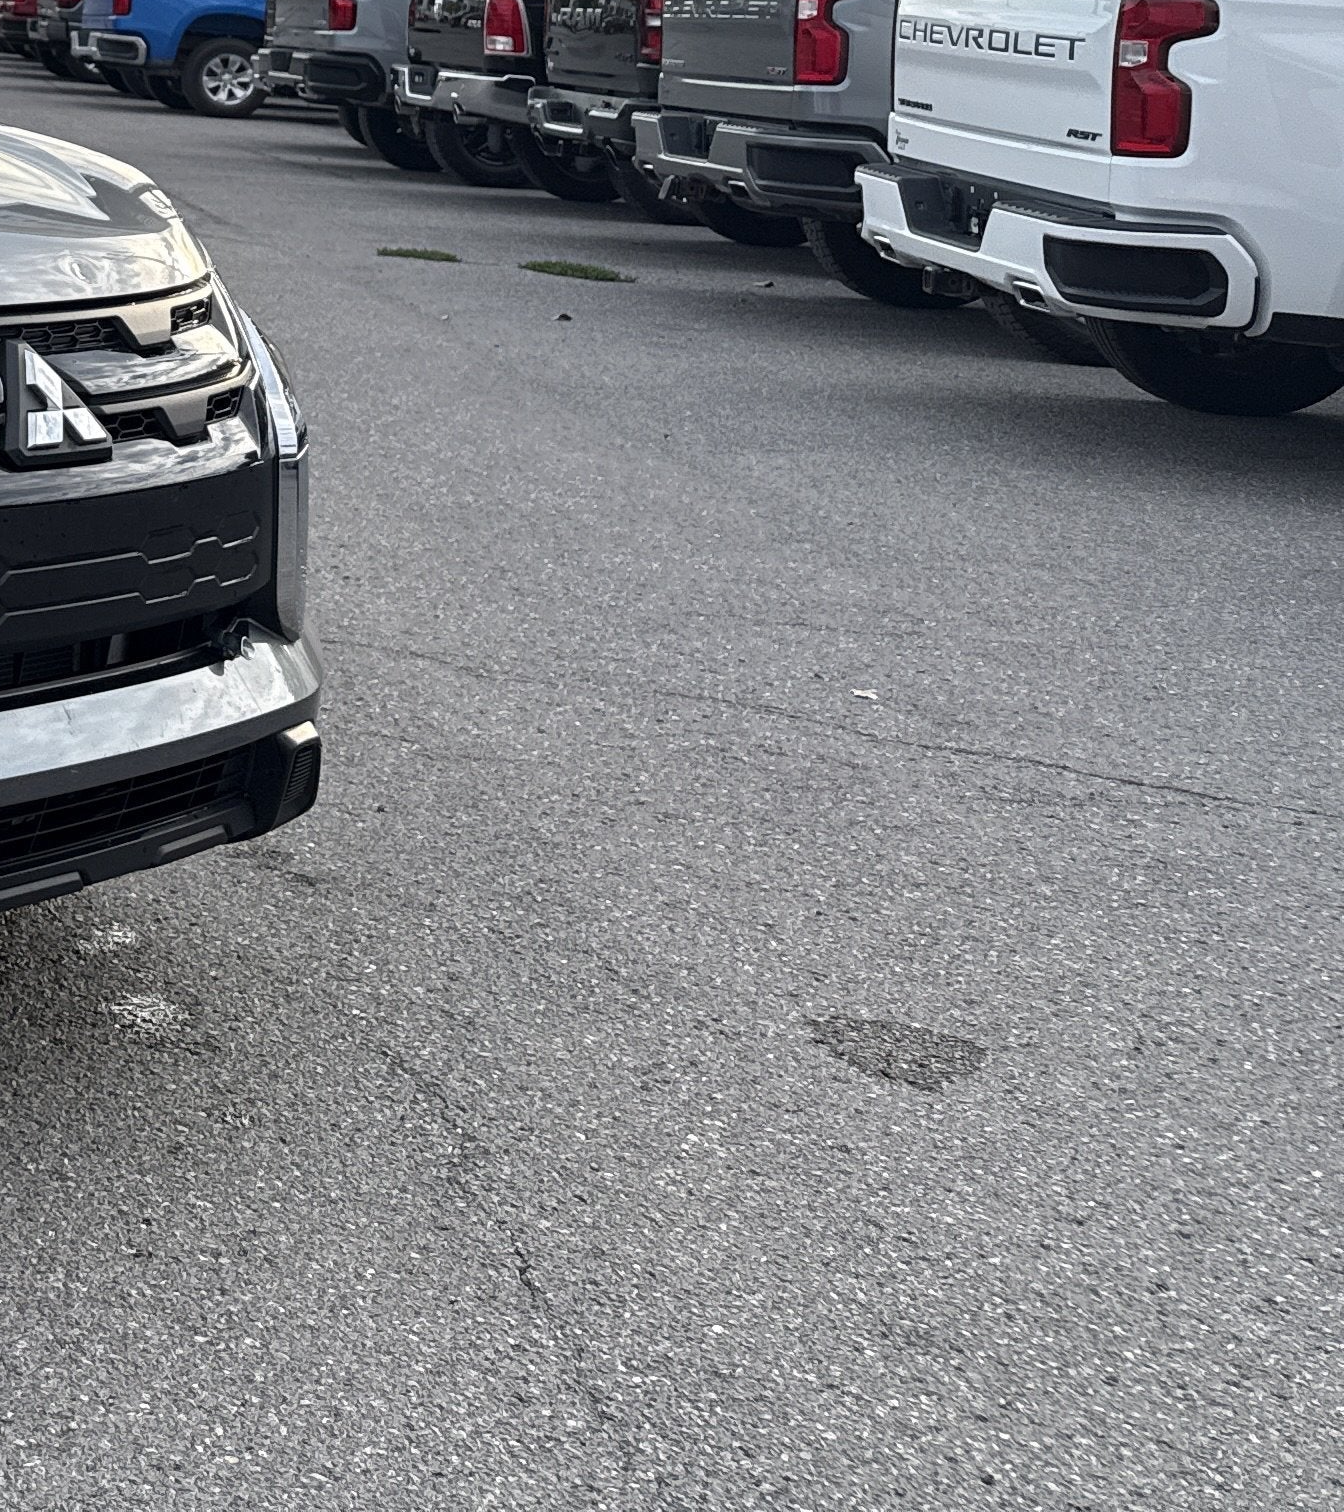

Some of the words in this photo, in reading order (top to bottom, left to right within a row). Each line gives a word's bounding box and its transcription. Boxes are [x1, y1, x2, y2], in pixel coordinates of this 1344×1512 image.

[558, 7, 603, 29] RAM
[898, 19, 1087, 61] CHEVROLET
[1065, 128, 1103, 142] RST
